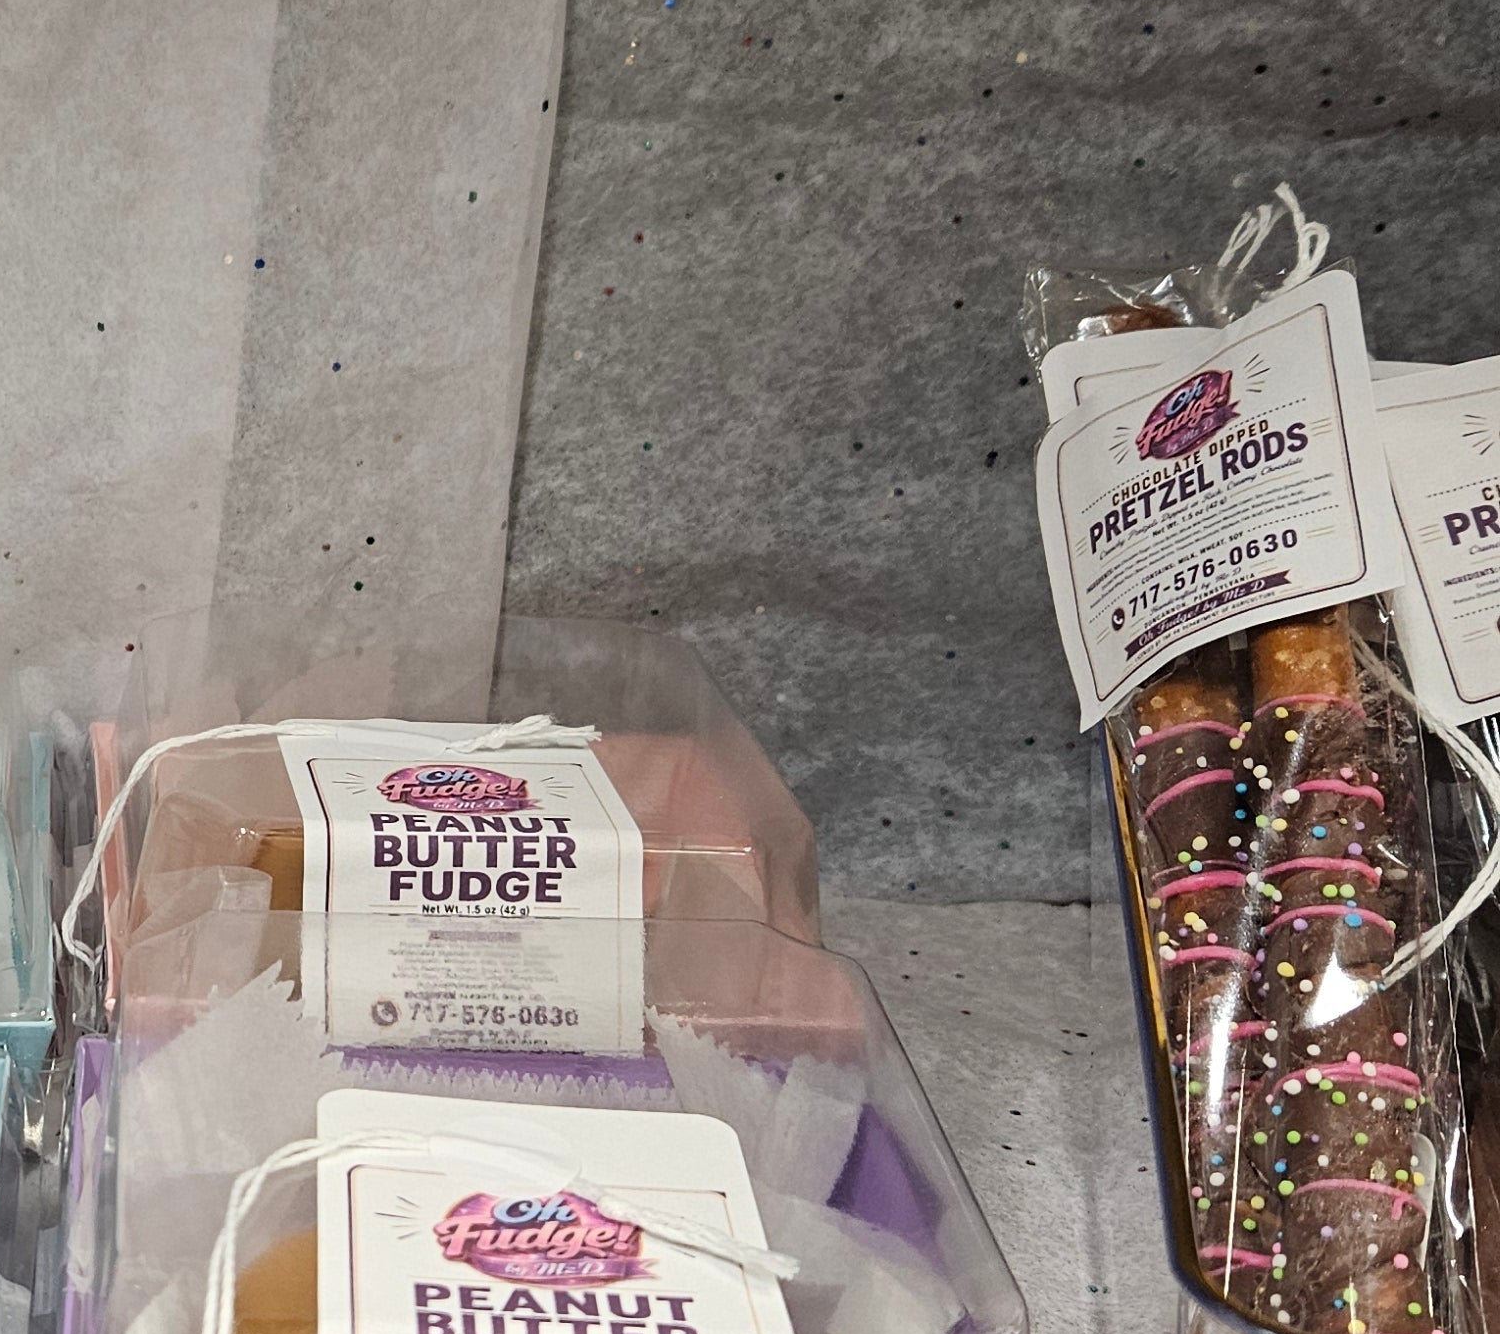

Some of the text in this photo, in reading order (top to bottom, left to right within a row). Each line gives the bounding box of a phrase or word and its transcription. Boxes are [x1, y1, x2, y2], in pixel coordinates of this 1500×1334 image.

[1166, 378, 1207, 417] Oh
[1135, 370, 1233, 461] Fudge!
[1112, 451, 1202, 506] CHOCOLATE
[1209, 419, 1269, 457] DIPPED
[1090, 464, 1214, 555] PRETZEL
[1220, 422, 1309, 481] RODS
[1228, 531, 1244, 542] SOY
[1128, 529, 1298, 618] 717-576-0630
[1193, 572, 1256, 602] PENNSYLVANIA
[1250, 578, 1266, 592] D
[377, 778, 528, 802] Fudge!
[416, 767, 479, 784] Oh
[370, 813, 571, 834] PEANUT
[374, 835, 577, 868] BUTTER
[389, 870, 563, 903] FUDGE
[422, 904, 440, 914] Net
[444, 905, 462, 914] Wt.
[466, 905, 480, 914] 1.5
[500, 905, 516, 916] (42
[493, 1196, 577, 1225] Oh
[434, 1216, 638, 1261] Fudge!
[414, 1282, 695, 1322] PEANUT
